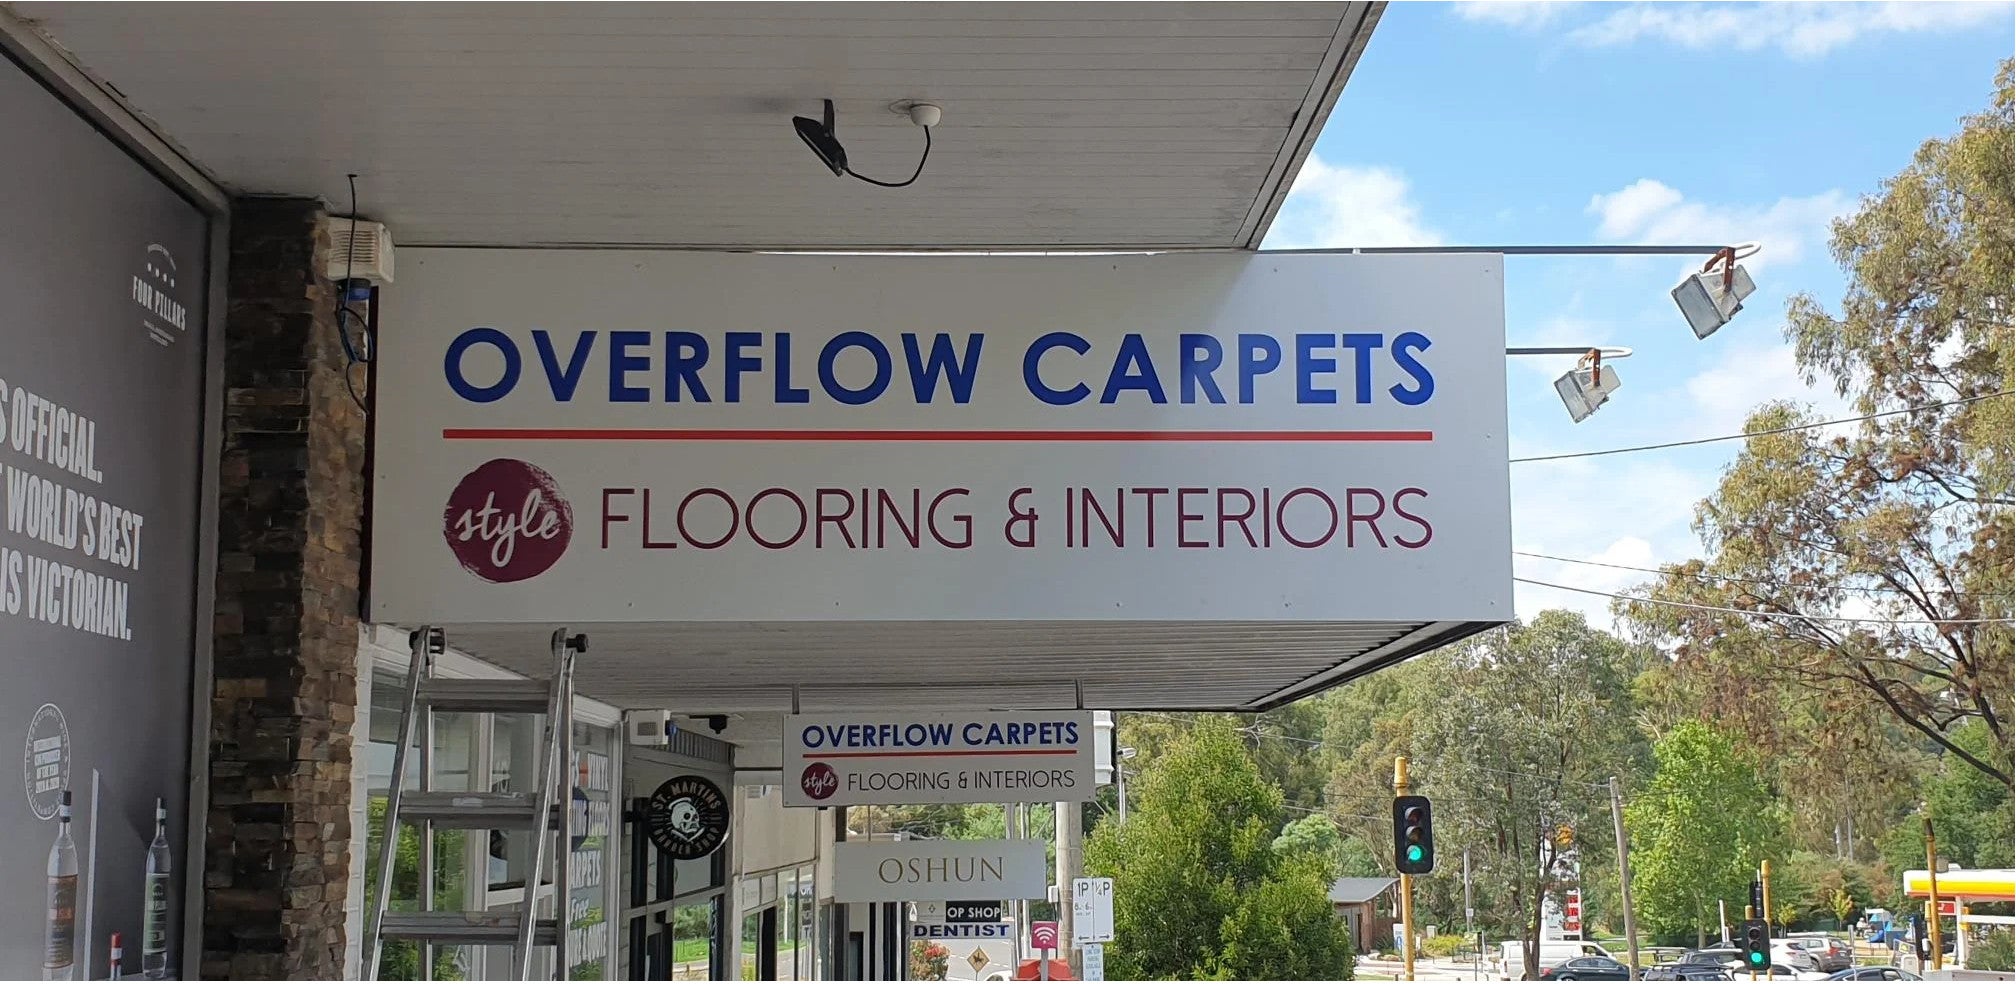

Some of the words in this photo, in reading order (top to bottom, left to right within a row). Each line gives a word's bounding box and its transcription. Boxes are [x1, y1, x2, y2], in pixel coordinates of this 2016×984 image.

[132, 275, 153, 311] FOUR
[154, 290, 186, 331] PILLARS
[444, 327, 985, 405] OVERFLOW
[1022, 331, 1435, 406] CARPETS
[11, 386, 103, 483] OFFICIAL.
[7, 465, 97, 556] WORLD'S
[98, 501, 144, 571] BEST
[454, 488, 563, 568] style
[601, 487, 973, 549] FLOORING
[1004, 487, 1039, 548] &
[1066, 487, 1434, 549] INTERIORS
[0, 547, 23, 615] IS
[27, 554, 132, 641] VICTORIAN.
[802, 723, 953, 748] OVERFLOW
[962, 721, 1079, 745] CARPETS
[670, 781, 721, 810] MARTINS
[803, 769, 836, 796] style
[848, 771, 950, 791] FLOORING
[958, 771, 967, 789] &
[974, 770, 1075, 789] INTERIORS
[569, 849, 601, 890] ARPETS
[879, 857, 1003, 884] OSHUN
[1077, 882, 1089, 897] 1P
[947, 906, 965, 918] OP
[967, 906, 1000, 918] SHOP
[914, 924, 1010, 937] DENTIST
